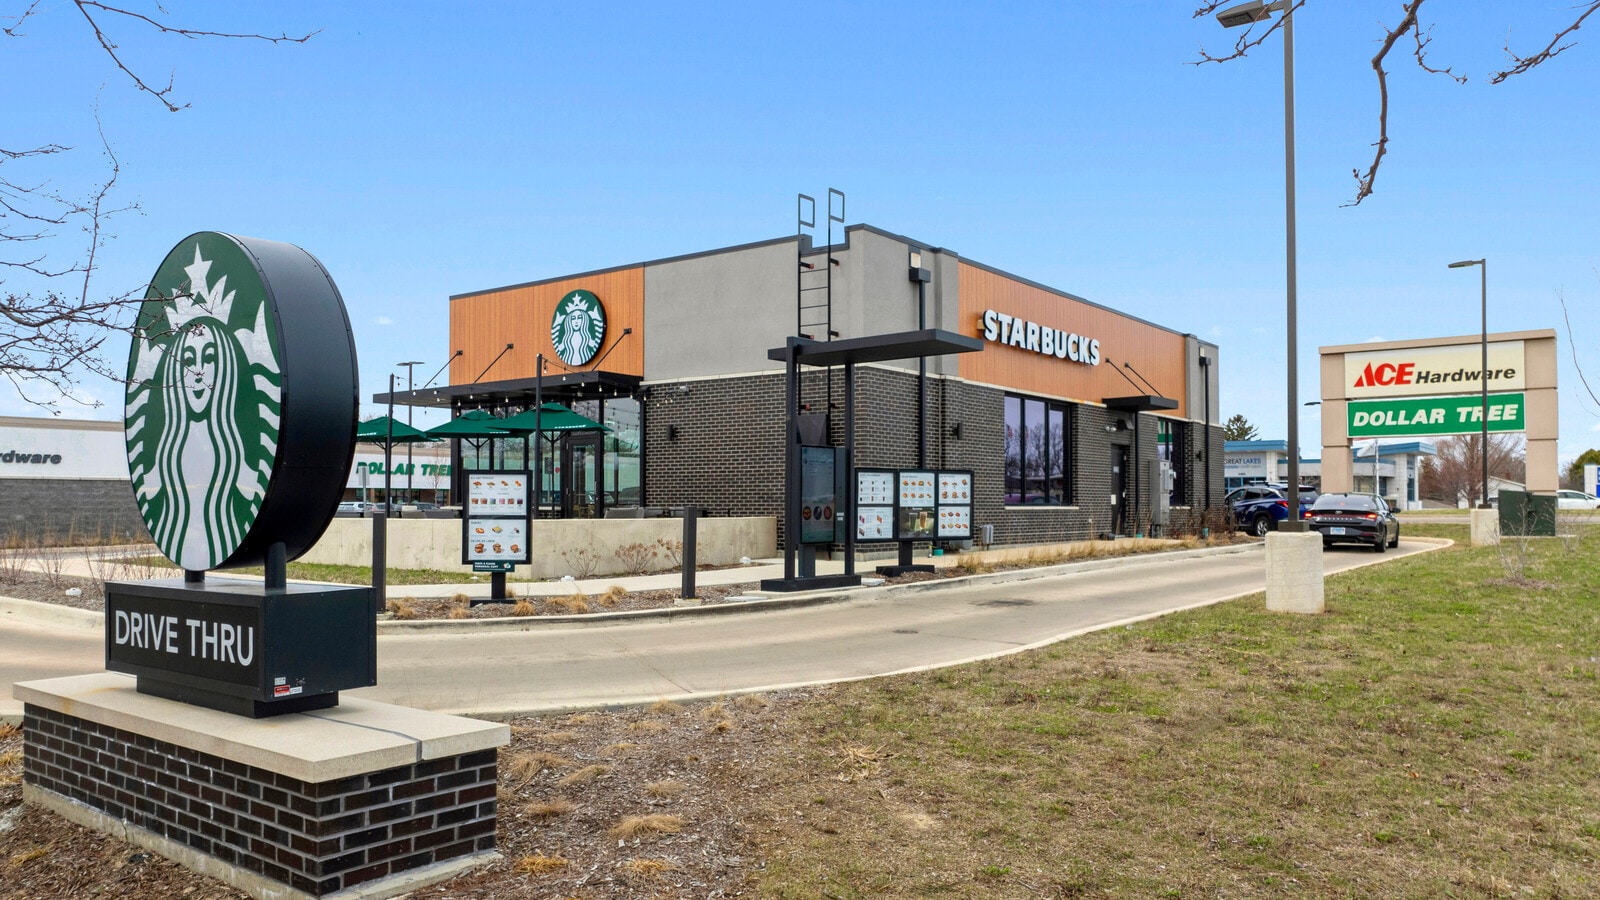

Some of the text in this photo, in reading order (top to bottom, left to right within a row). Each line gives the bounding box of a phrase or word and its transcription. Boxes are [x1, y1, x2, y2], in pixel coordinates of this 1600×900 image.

[983, 309, 1100, 366] STARBUCKS
[1353, 362, 1516, 388] ACE Hardware
[1353, 404, 1519, 427] DOLLAR TREE
[0, 450, 62, 465] dware
[115, 610, 253, 667] DRIVE THRU
